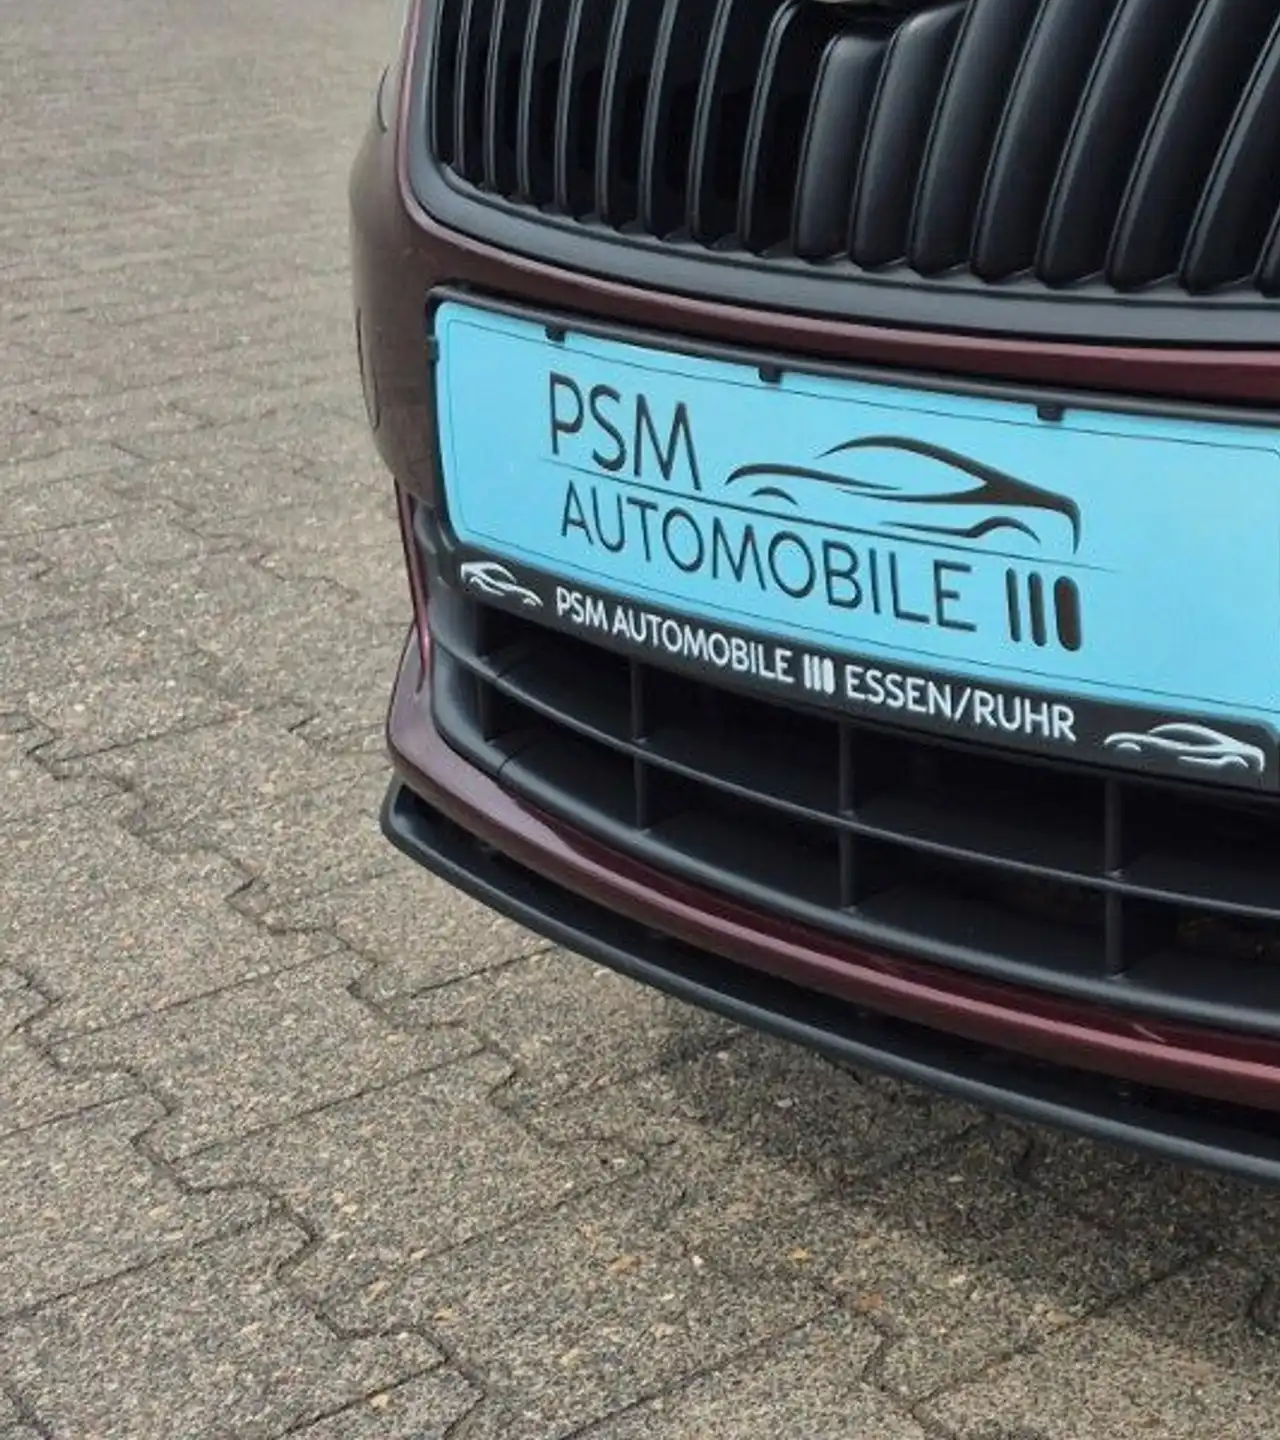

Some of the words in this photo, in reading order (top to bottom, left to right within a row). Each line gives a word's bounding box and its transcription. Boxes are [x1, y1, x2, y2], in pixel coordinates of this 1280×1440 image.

[549, 370, 702, 491] PSM
[560, 479, 978, 633] AUTOMOBILE
[556, 586, 610, 633] PSM
[612, 603, 795, 683] AUTOMOBILE
[845, 664, 1078, 742] ESSEN/RUHR
